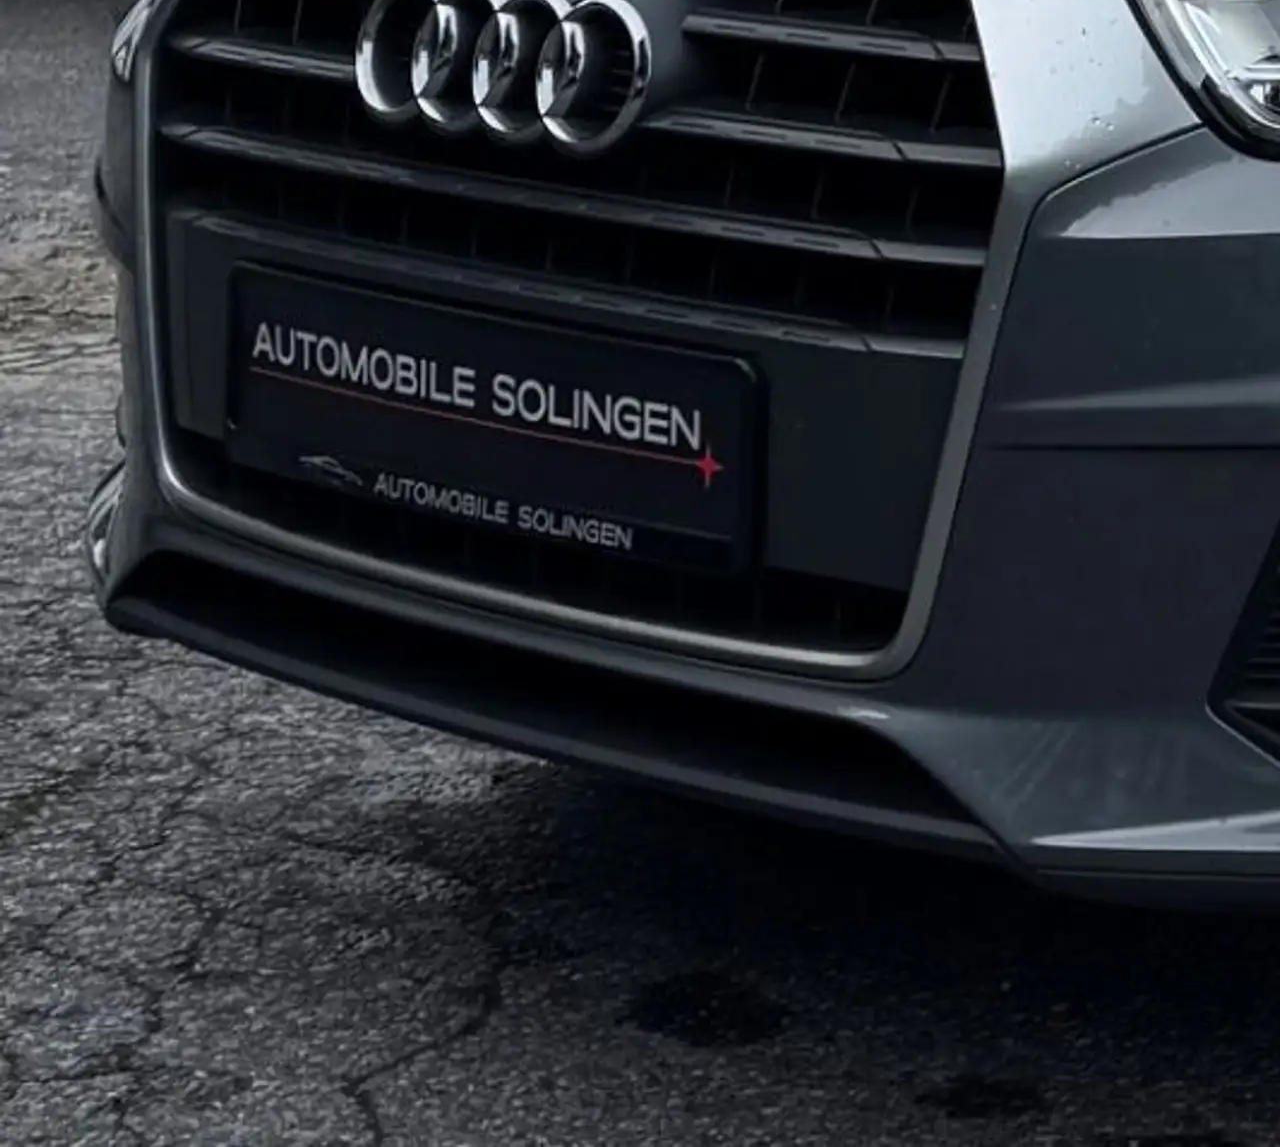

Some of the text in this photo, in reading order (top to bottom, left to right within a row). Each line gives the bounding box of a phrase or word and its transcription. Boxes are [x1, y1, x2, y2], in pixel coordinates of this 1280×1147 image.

[252, 321, 702, 451] AUTOMOBILE SOLINGEN
[373, 472, 633, 551] AUTOMOBILE SOLINGEN
